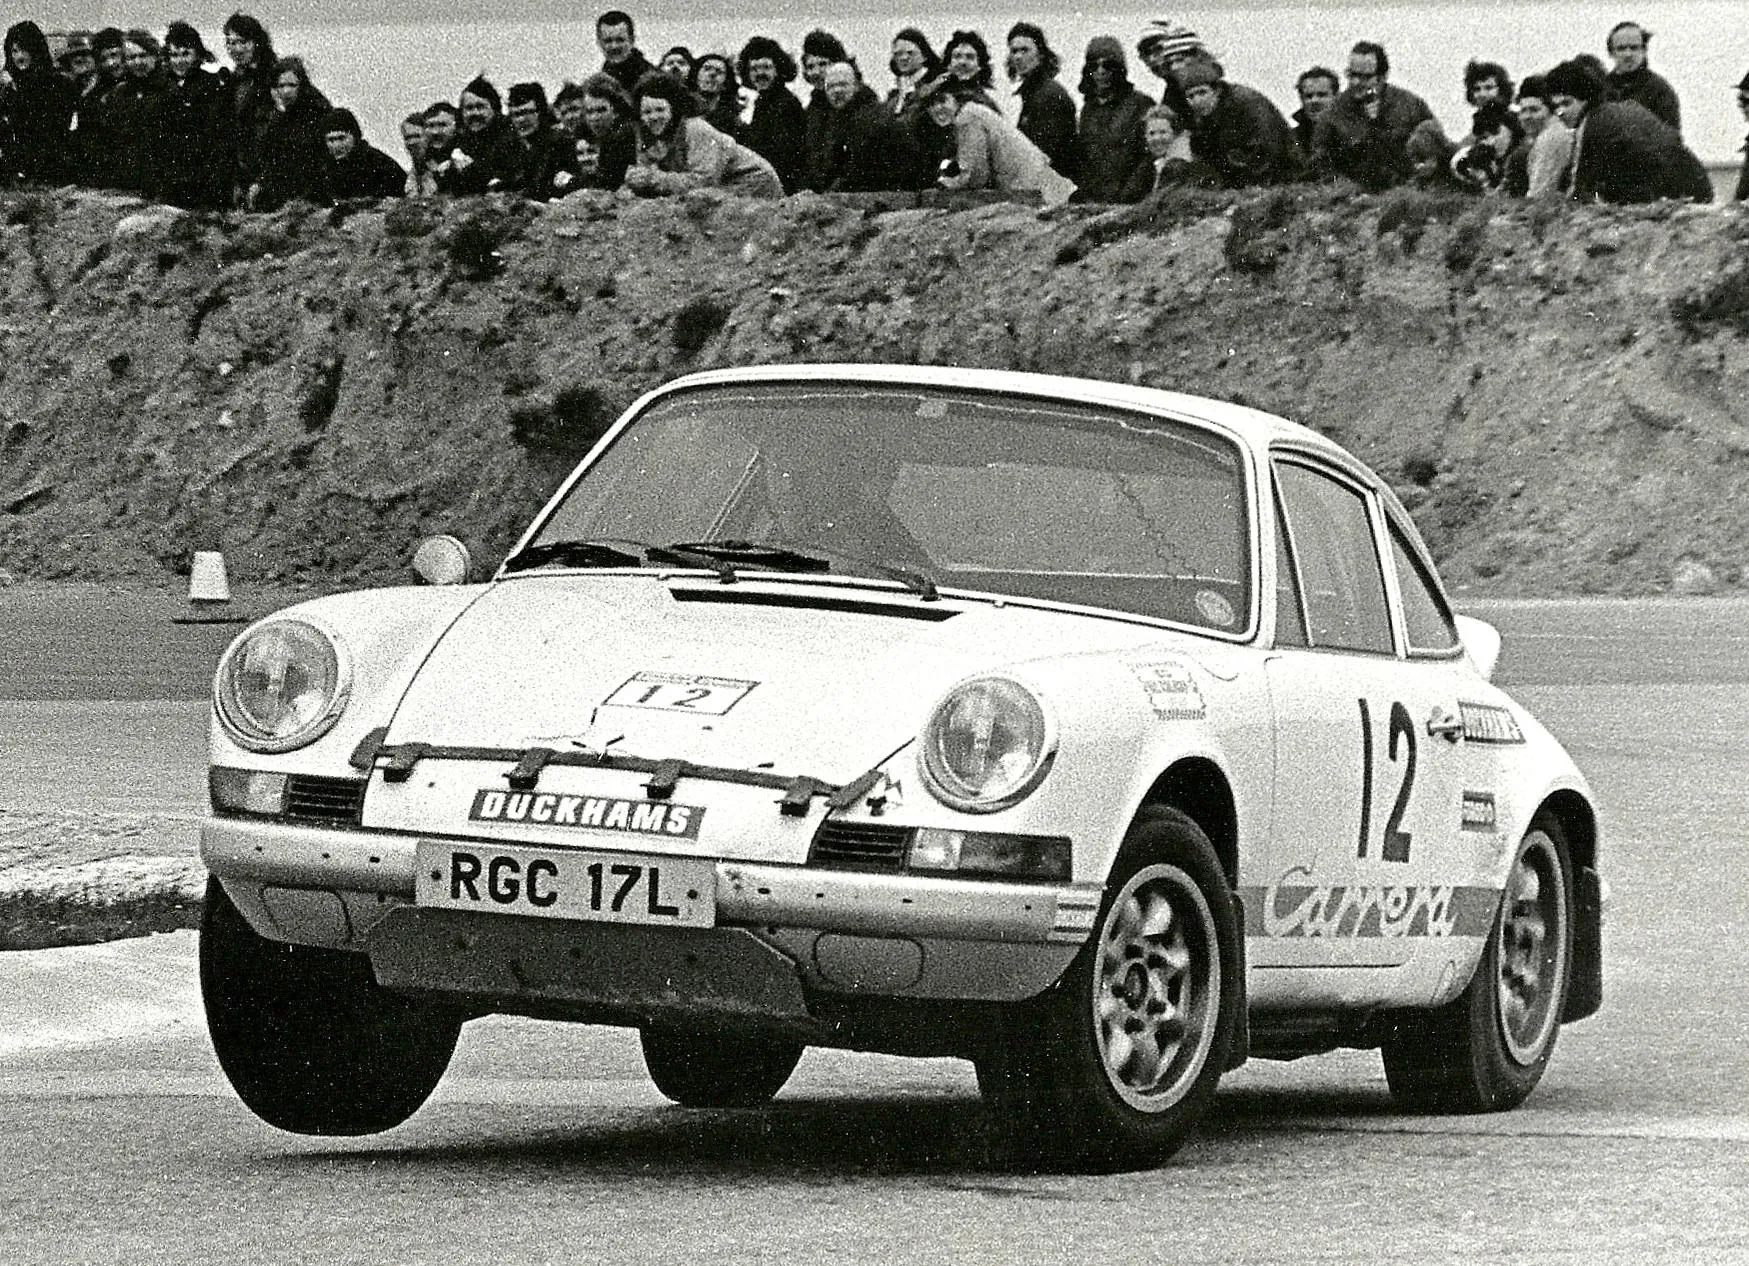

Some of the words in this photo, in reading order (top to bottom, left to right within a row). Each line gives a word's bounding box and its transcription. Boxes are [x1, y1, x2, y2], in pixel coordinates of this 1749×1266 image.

[637, 685, 712, 707] 12
[1357, 698, 1417, 863] 12
[480, 791, 691, 834] DUCKHAMS
[451, 852, 558, 907] RGC
[587, 863, 679, 916] 17L
